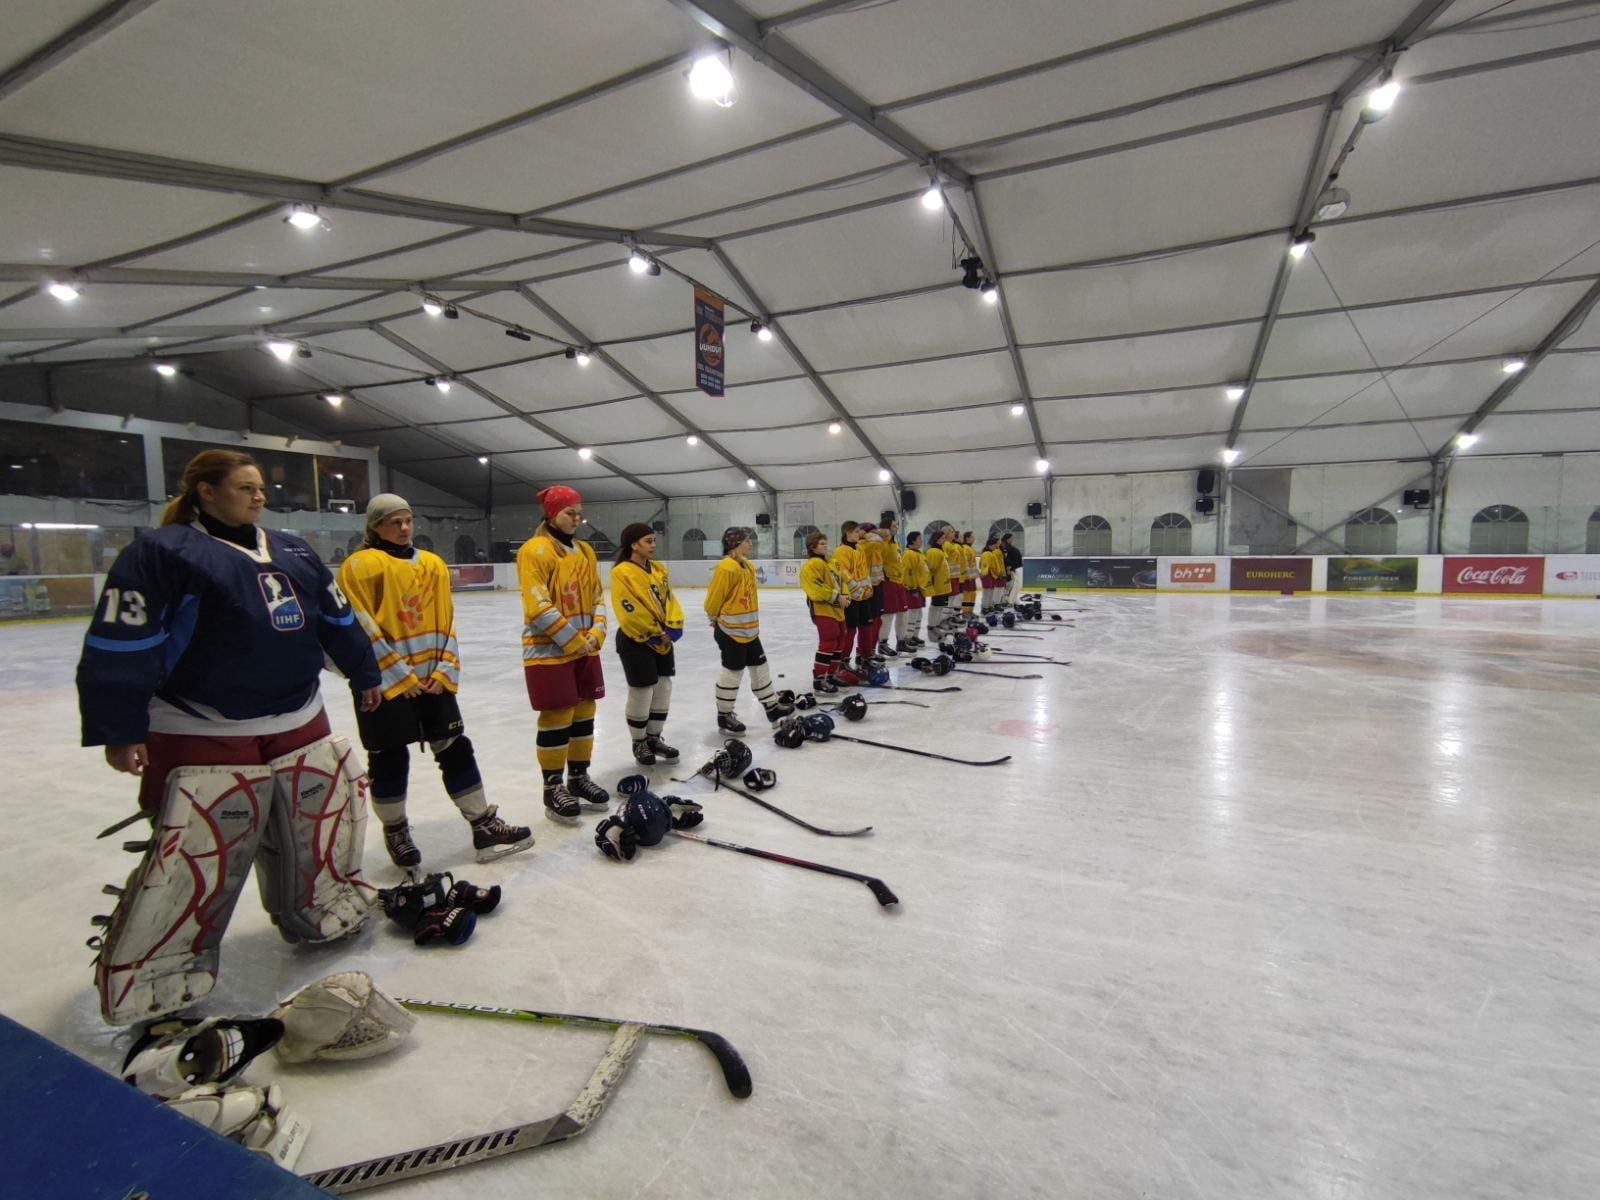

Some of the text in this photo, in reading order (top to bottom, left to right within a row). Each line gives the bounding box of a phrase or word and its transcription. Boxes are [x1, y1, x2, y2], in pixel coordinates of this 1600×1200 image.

[1246, 571, 1295, 579] EUROHERC
[102, 587, 148, 626] 13
[274, 613, 301, 626] IIHF
